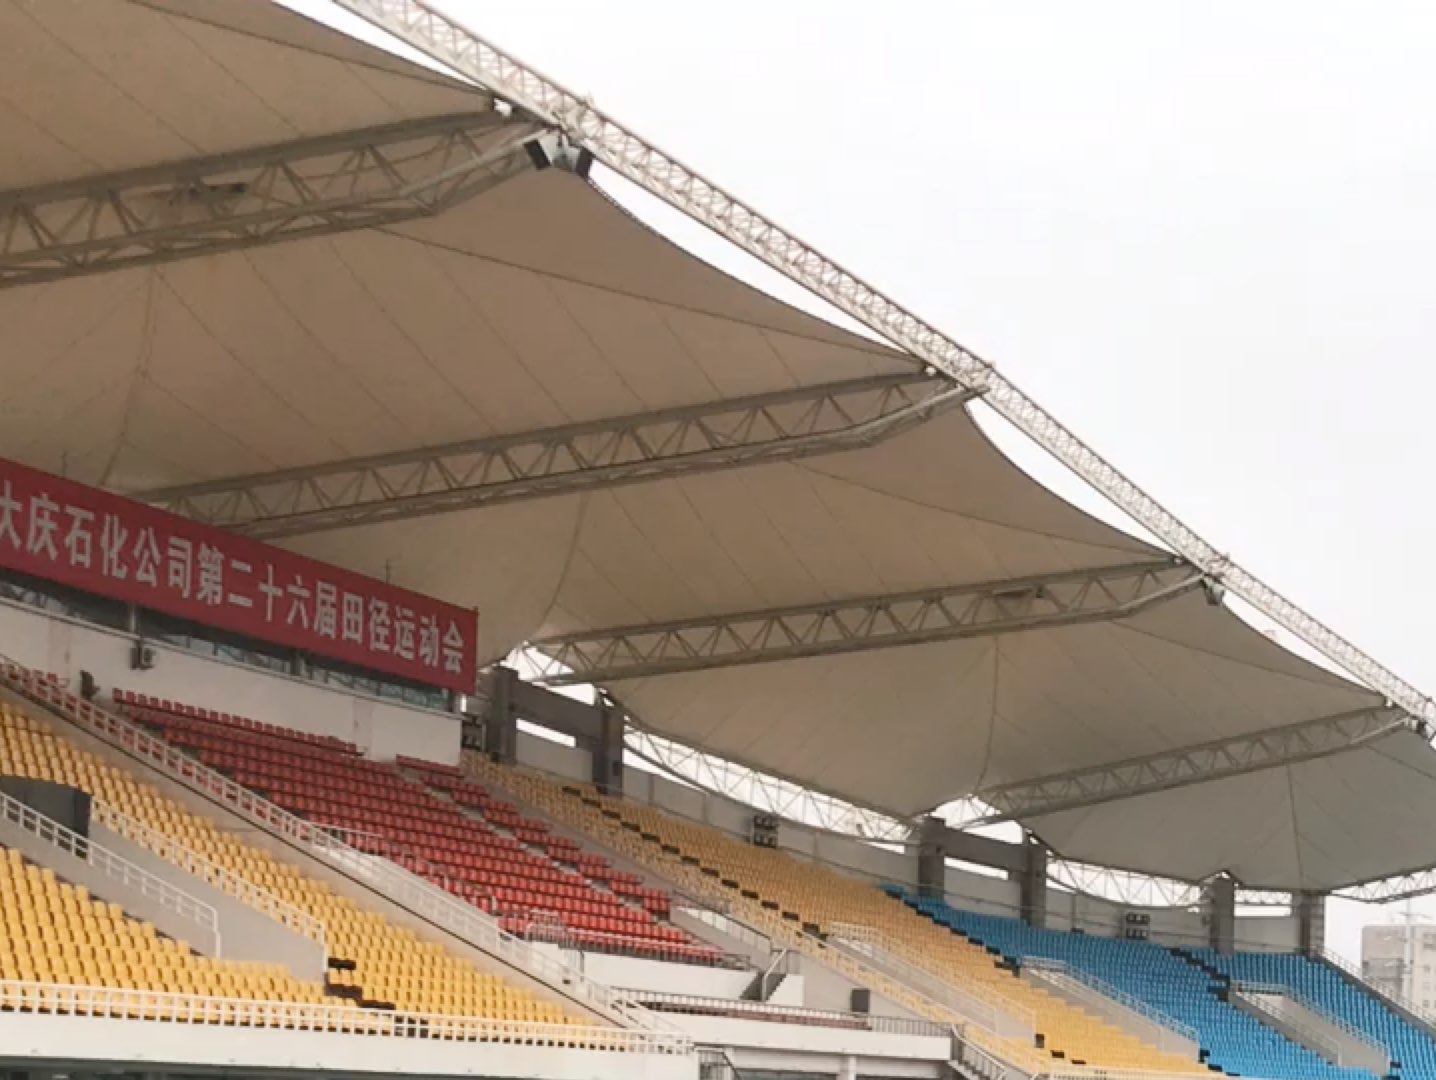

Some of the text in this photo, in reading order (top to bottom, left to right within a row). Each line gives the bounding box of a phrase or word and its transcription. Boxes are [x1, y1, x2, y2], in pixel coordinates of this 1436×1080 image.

[0, 480, 465, 674] 大庆石化公司第二十六届田径运动会
